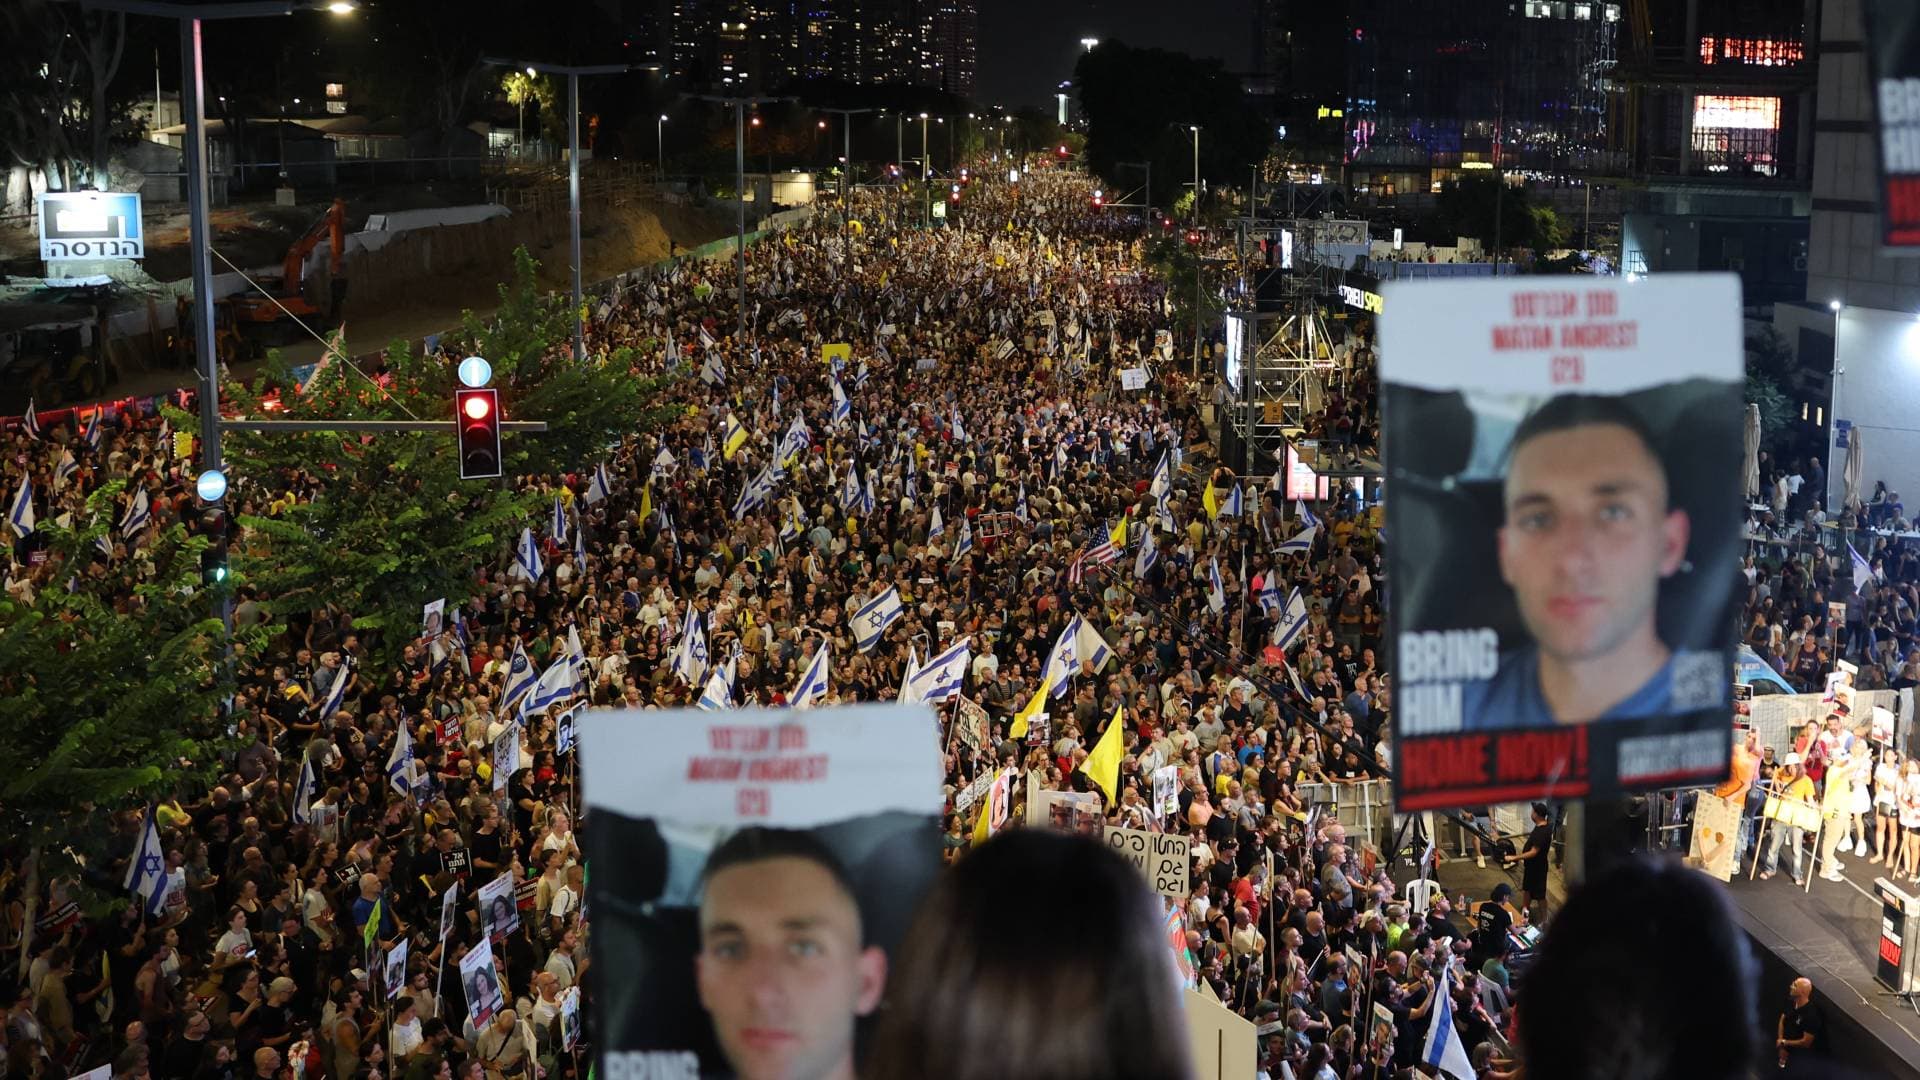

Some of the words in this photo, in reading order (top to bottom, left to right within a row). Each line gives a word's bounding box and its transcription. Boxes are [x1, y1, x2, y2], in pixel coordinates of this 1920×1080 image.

[50, 241, 139, 257] הנדסה
[1491, 325, 1552, 350] MATAN
[1399, 627, 1499, 683] BRING
[1399, 682, 1463, 735] HIM
[1401, 733, 1489, 790] HOME
[1496, 722, 1590, 779] NOW!
[452, 852, 464, 860] אל
[1156, 860, 1183, 876] גם
[1156, 877, 1184, 894] וגם
[1880, 936, 1902, 962] NOW
